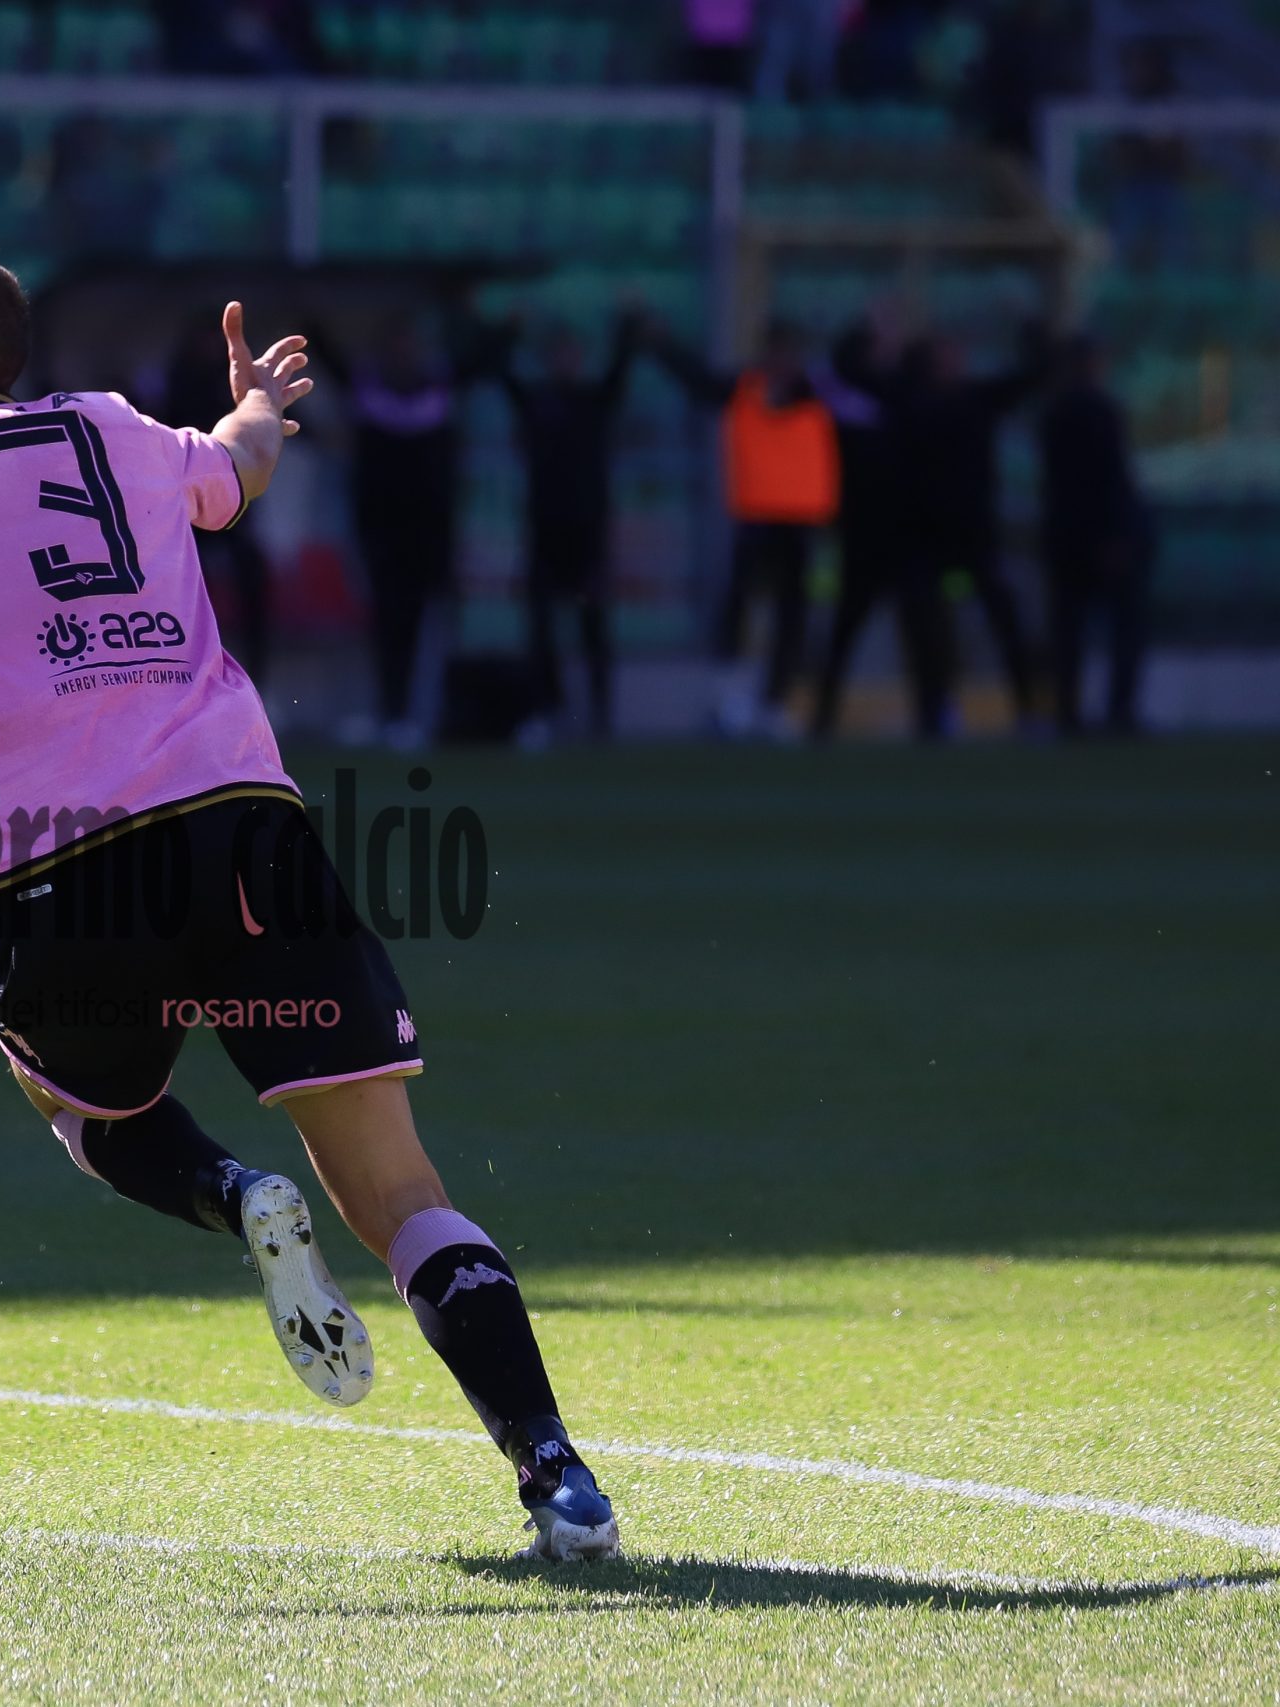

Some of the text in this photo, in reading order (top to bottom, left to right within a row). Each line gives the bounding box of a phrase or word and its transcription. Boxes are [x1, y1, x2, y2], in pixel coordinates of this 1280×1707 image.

[54, 670, 194, 697] ENERGY SERVICE COMPANY
